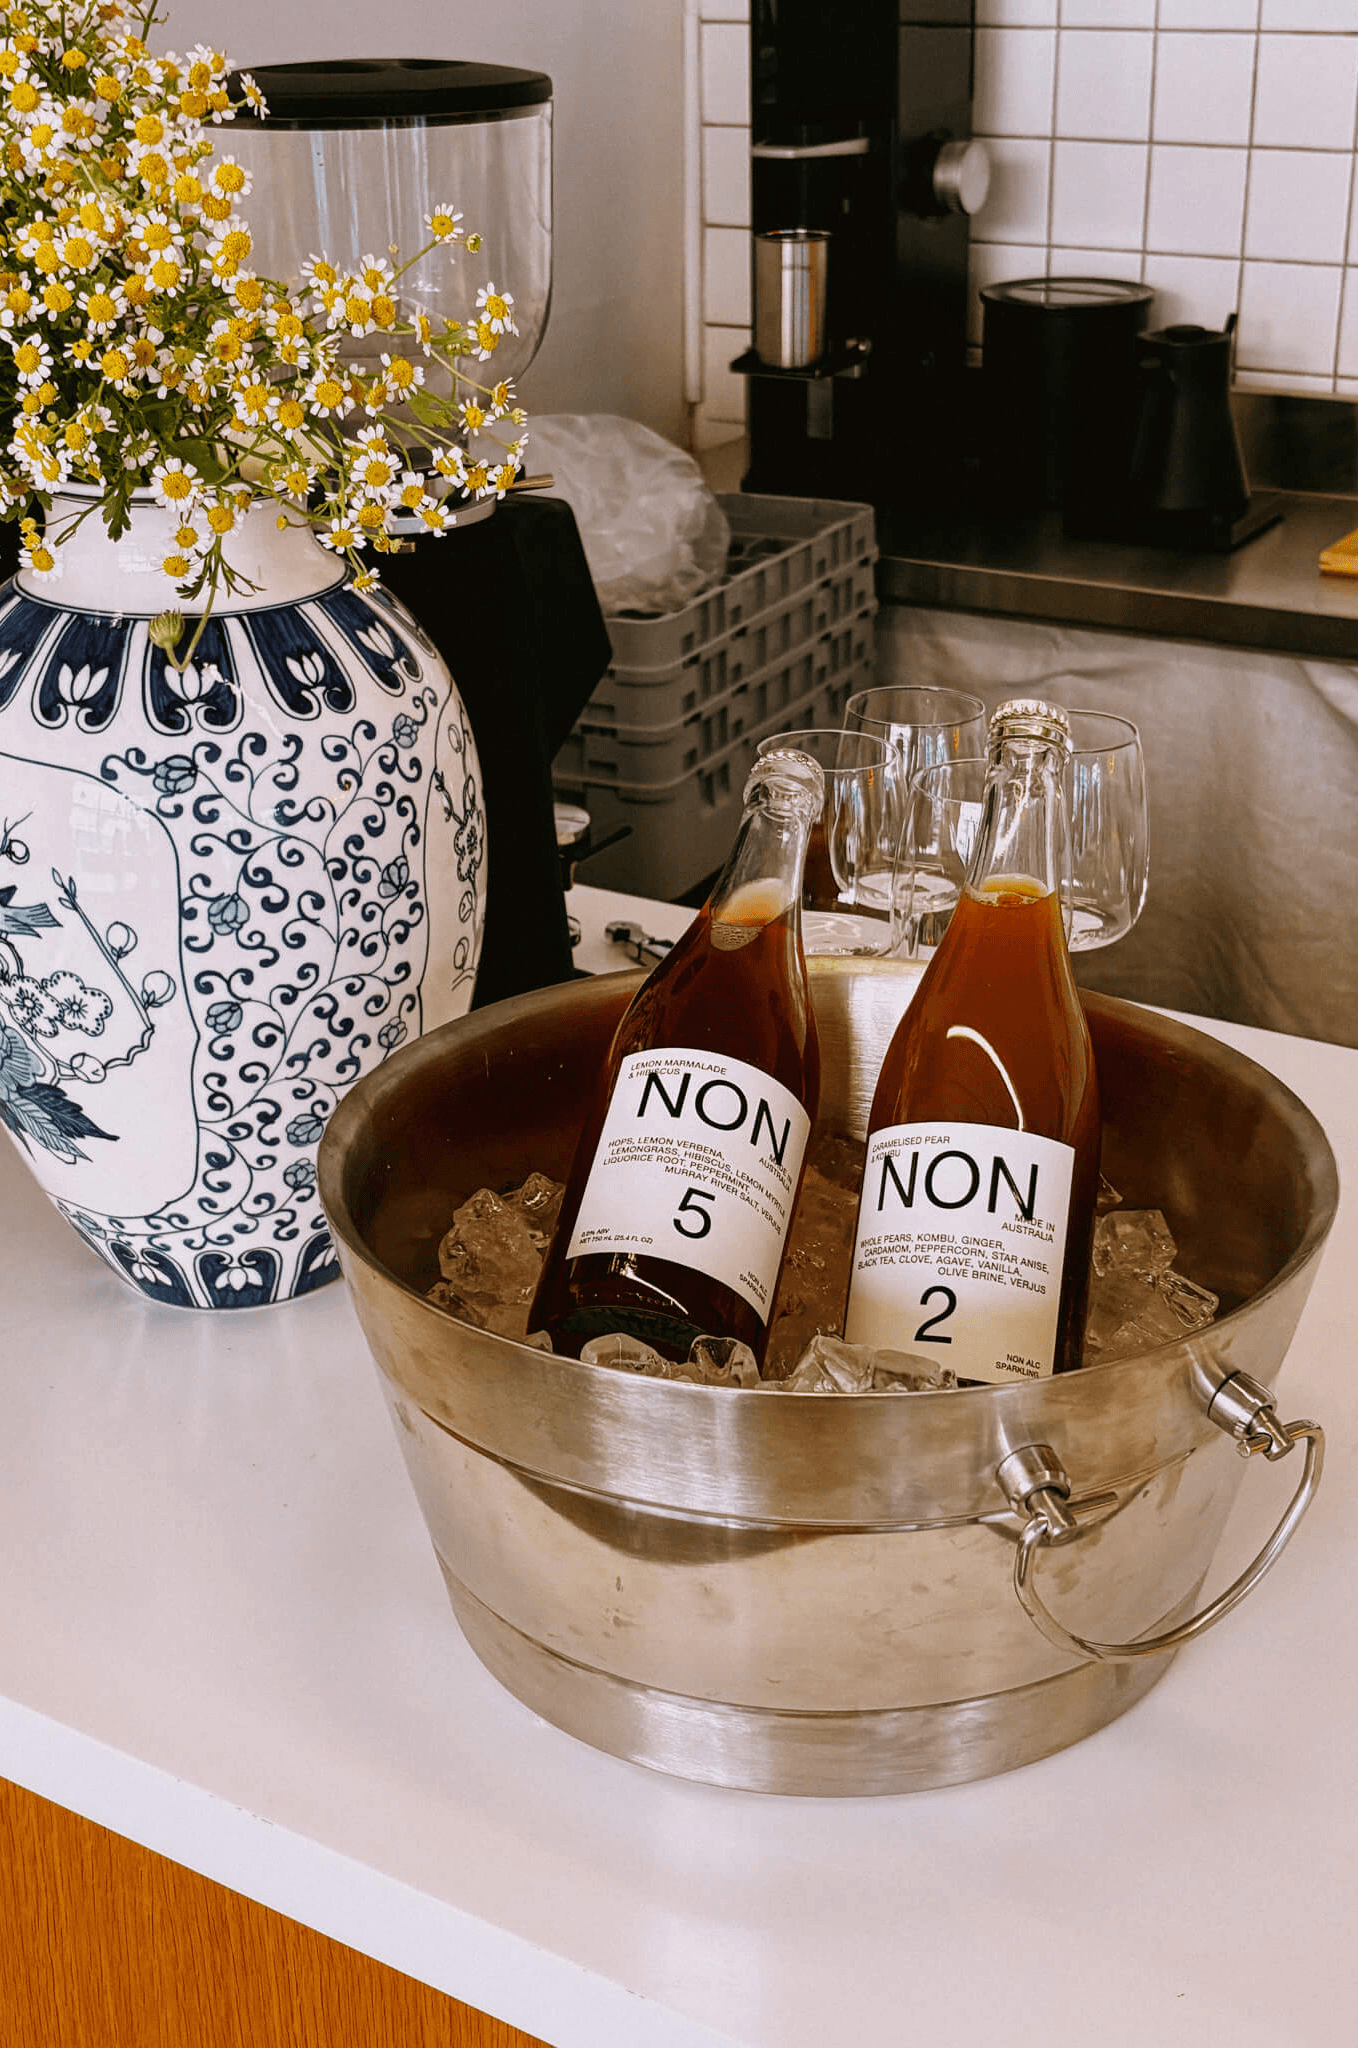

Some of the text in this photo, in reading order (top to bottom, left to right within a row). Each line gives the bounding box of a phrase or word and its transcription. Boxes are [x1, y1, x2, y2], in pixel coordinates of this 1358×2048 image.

[631, 1059, 727, 1075] LEMON MARMALADE
[637, 1072, 791, 1166] NON
[608, 1137, 725, 1161] HOPS, LEMON VERBENA,
[872, 1136, 951, 1152] CARAMELISED PEAR
[603, 1154, 750, 1194] LIQUORICE ROOT, PEPPERMINT,
[611, 1146, 680, 1157] LEMONGRASS,
[684, 1151, 733, 1175] HIBISCUS,
[736, 1169, 764, 1193] LEMON
[759, 1157, 791, 1193] AUSTRALIA
[769, 1154, 787, 1177] MDE
[665, 1165, 709, 1182] MURRAY
[711, 1178, 738, 1196] RIVER
[740, 1192, 760, 1212] SALT,
[877, 1150, 1039, 1221] NON
[673, 1187, 716, 1239] 5
[1001, 1222, 1054, 1243] AUSTRALIA
[1045, 1222, 1055, 1233] IN
[861, 1233, 1005, 1251] WHOLE PEARS, KOMBU, GINGER,
[858, 1255, 1022, 1277] BLACK TEA, CLOVE, AGAVE, VANILLA,
[864, 1244, 1049, 1274] CARDAMOM, PEPPERCORN, STAR ANISE,
[938, 1266, 1046, 1294] OLIVE BRINE, VERJUS
[914, 1285, 957, 1344] 2
[995, 1361, 1040, 1379] SPARKLING
[1006, 1353, 1041, 1369] NON ALC
